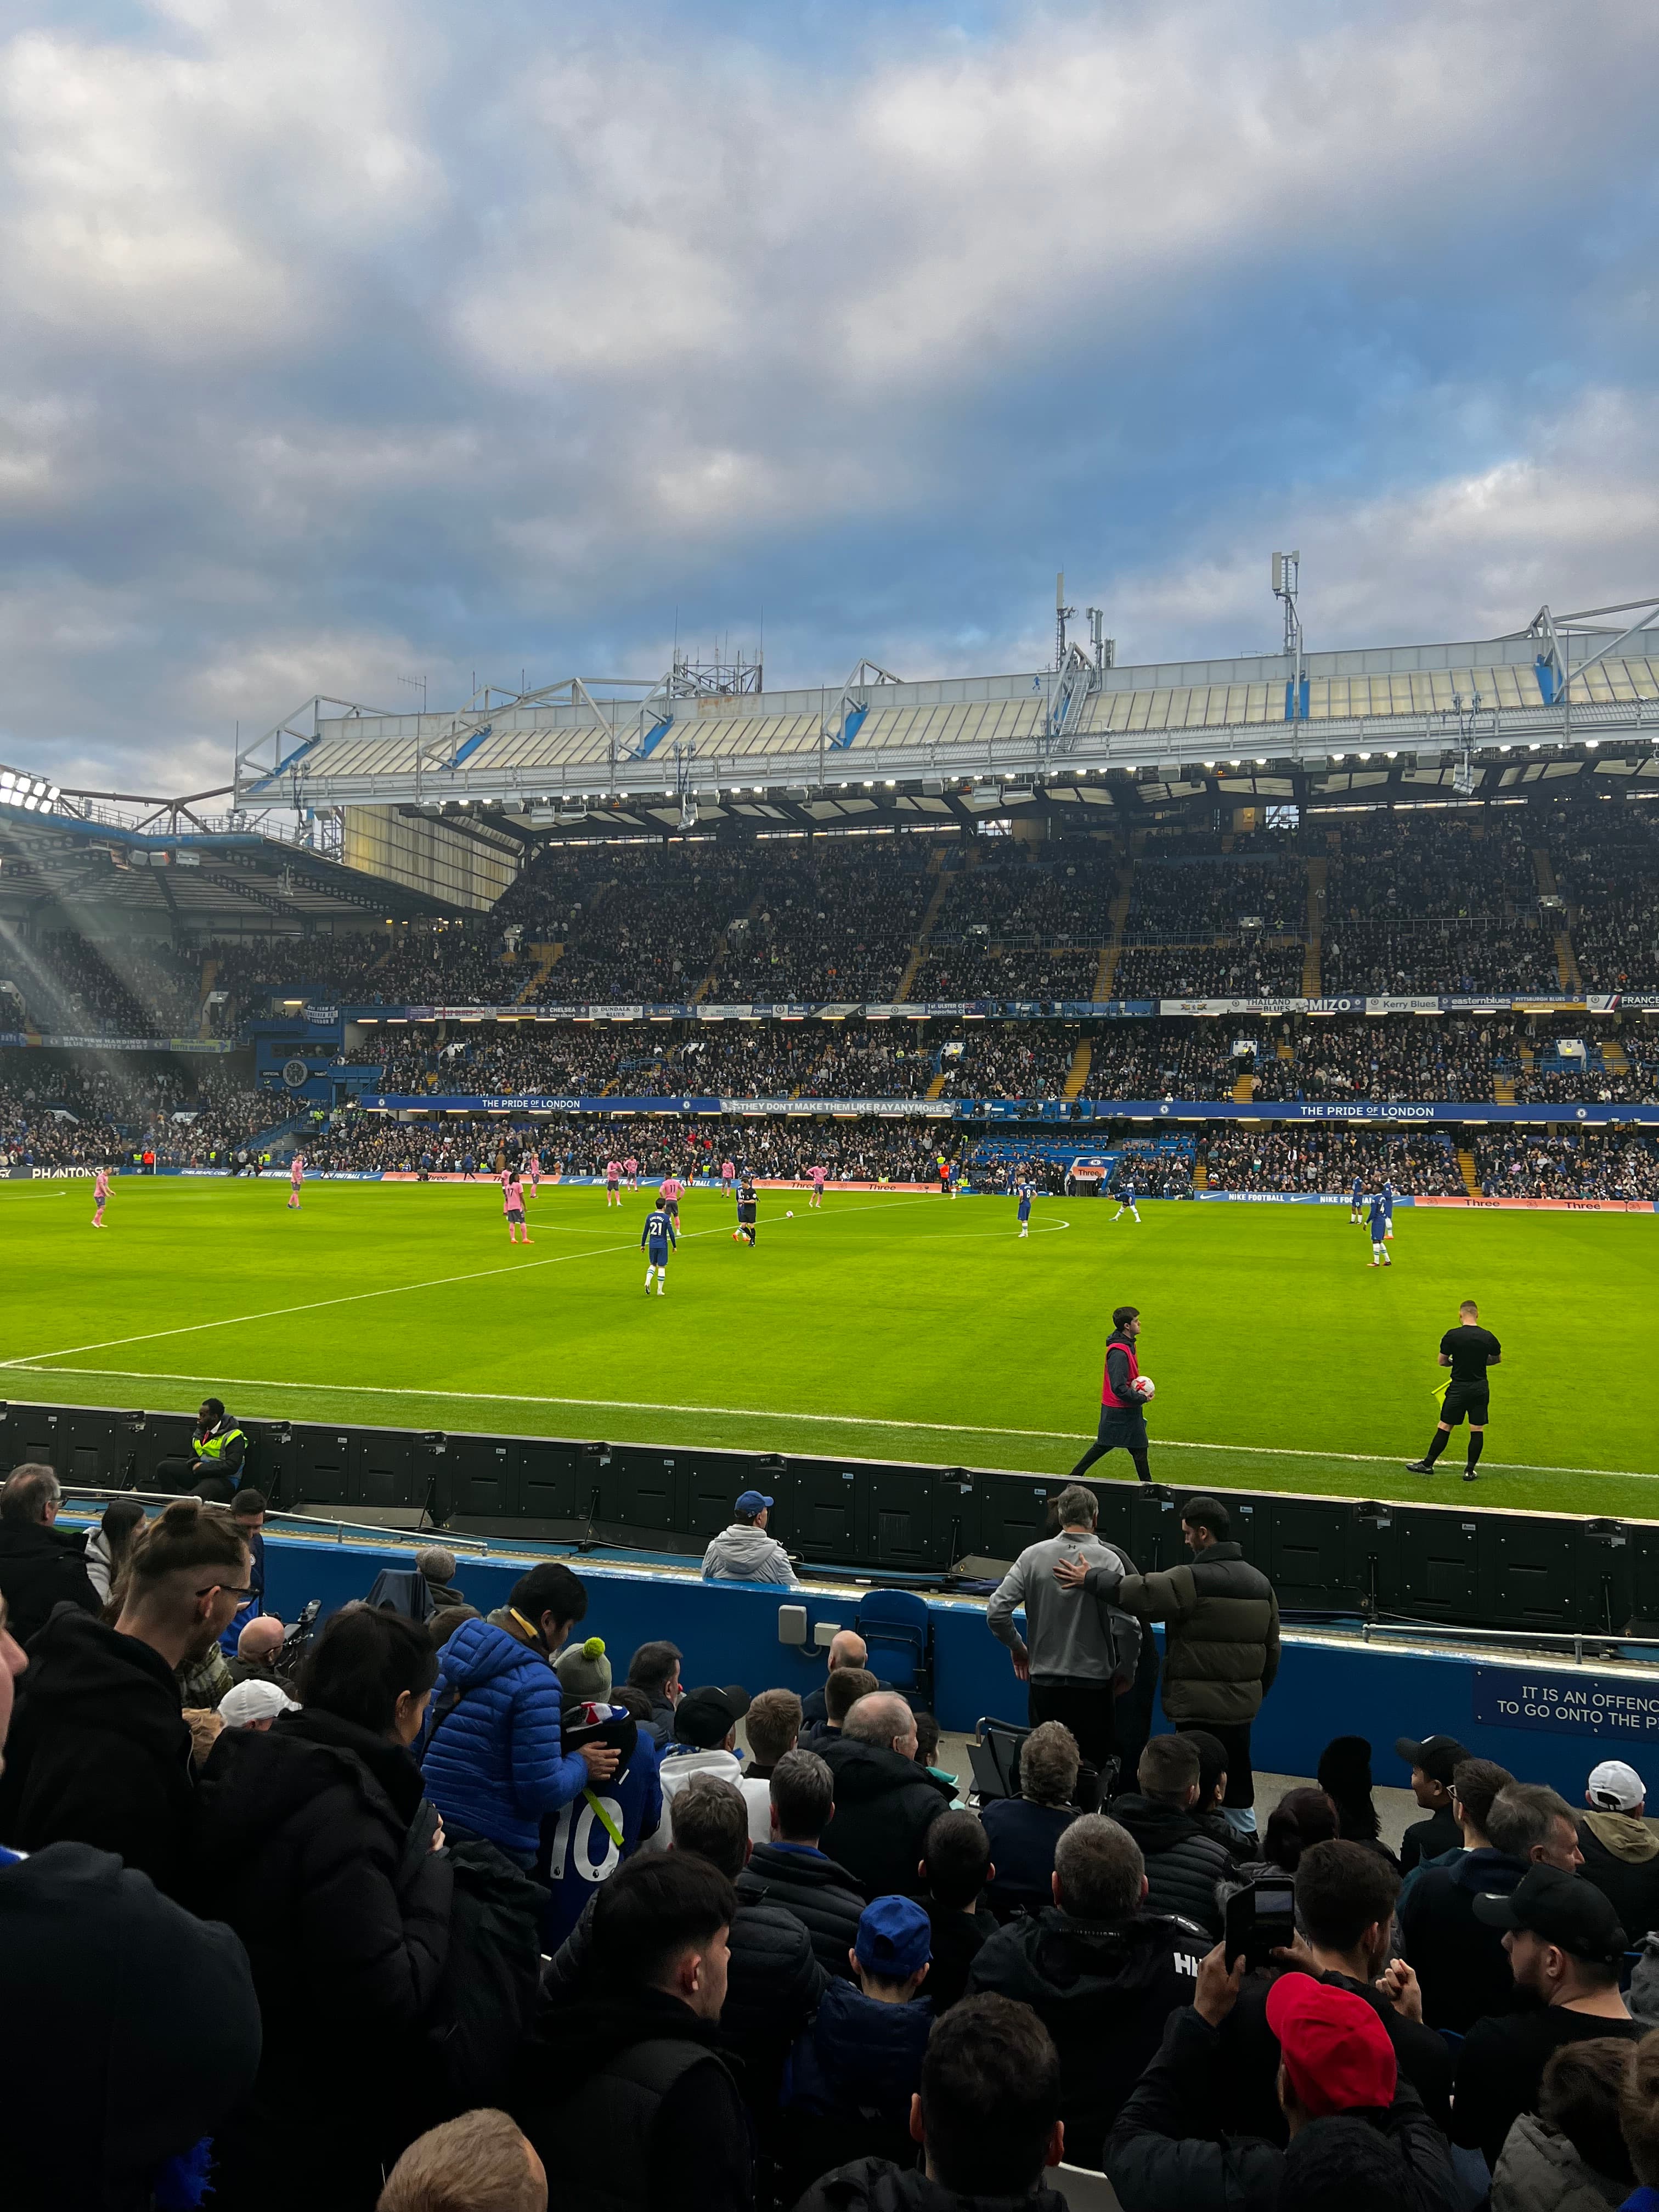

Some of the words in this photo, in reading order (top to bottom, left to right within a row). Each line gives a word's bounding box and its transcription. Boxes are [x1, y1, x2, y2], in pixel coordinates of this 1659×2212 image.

[1452, 997, 1511, 1005] easternblues
[1621, 996, 1659, 1004] FRANCE
[1309, 999, 1351, 1011] MIZO
[894, 1104, 942, 1112] ANYMORE
[1301, 1107, 1323, 1115] THE
[1327, 1107, 1363, 1116] PRIDE
[1366, 1107, 1378, 1115] OF
[1381, 1107, 1434, 1116] LONDON
[507, 1188, 514, 1197] 17
[1026, 1189, 1031, 1198] 8
[650, 1222, 662, 1235] 21
[1522, 1686, 1538, 1699] IT
[1542, 1689, 1558, 1701] IS
[1564, 1691, 1587, 1705] AN
[1497, 1700, 1519, 1714] TO
[1525, 1704, 1550, 1718] GO
[1555, 1707, 1603, 1724] ONTO
[1608, 1712, 1640, 1728] THE
[550, 1797, 624, 1882] 10
